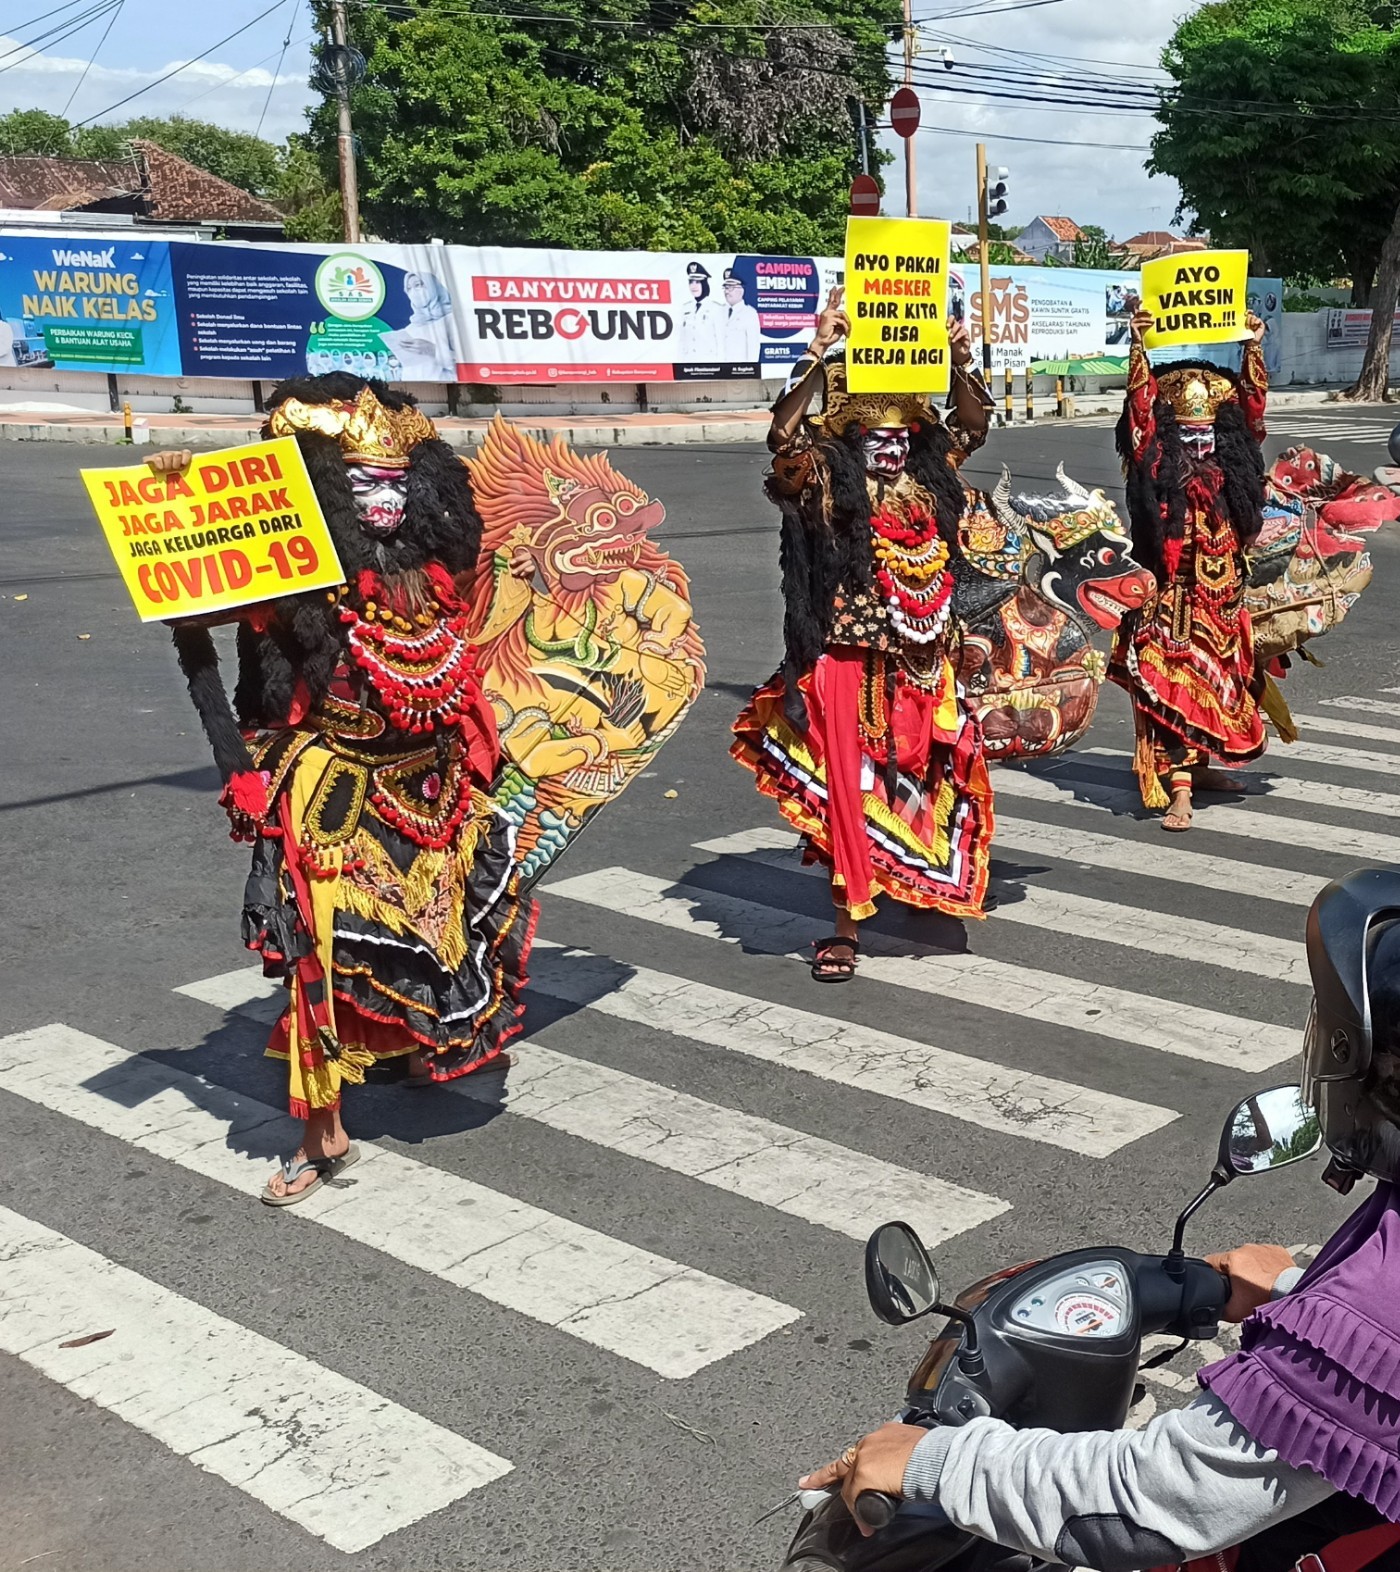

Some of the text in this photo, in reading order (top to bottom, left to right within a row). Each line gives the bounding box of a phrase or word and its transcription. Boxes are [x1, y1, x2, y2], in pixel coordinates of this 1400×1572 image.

[52, 246, 116, 268] WeNaK
[854, 253, 940, 274] AYO PAKAI
[756, 262, 812, 275] CAMPING
[1174, 265, 1220, 285] AYO
[33, 270, 139, 295] WARUNG
[487, 279, 660, 300] BANYUWANGI
[756, 277, 807, 290] EMBUN
[864, 277, 931, 297] MASKER
[22, 295, 157, 321] NAIK KELAS
[1158, 288, 1234, 309] VAKSIN
[857, 302, 938, 320] BIAR KITA
[50, 329, 135, 340] PERBAIKAN WARUNG KECIL
[474, 308, 673, 341] REBOUND
[881, 325, 919, 343] BISA
[970, 323, 1028, 344] PSAN
[60, 337, 91, 345] BANTUAN
[92, 338, 109, 346] ALAT
[110, 339, 132, 347] USAHA
[764, 347, 790, 355] GRATIS
[975, 347, 1023, 357] Sai Manak
[852, 348, 944, 365] KERJA LAGI
[1004, 358, 1026, 368] Pisan
[104, 453, 283, 507] JAGA DIRI
[118, 487, 294, 537] JAGA JARAK
[130, 513, 303, 558] JAGA KELUARGA DARI
[137, 535, 319, 603] COVID-19
